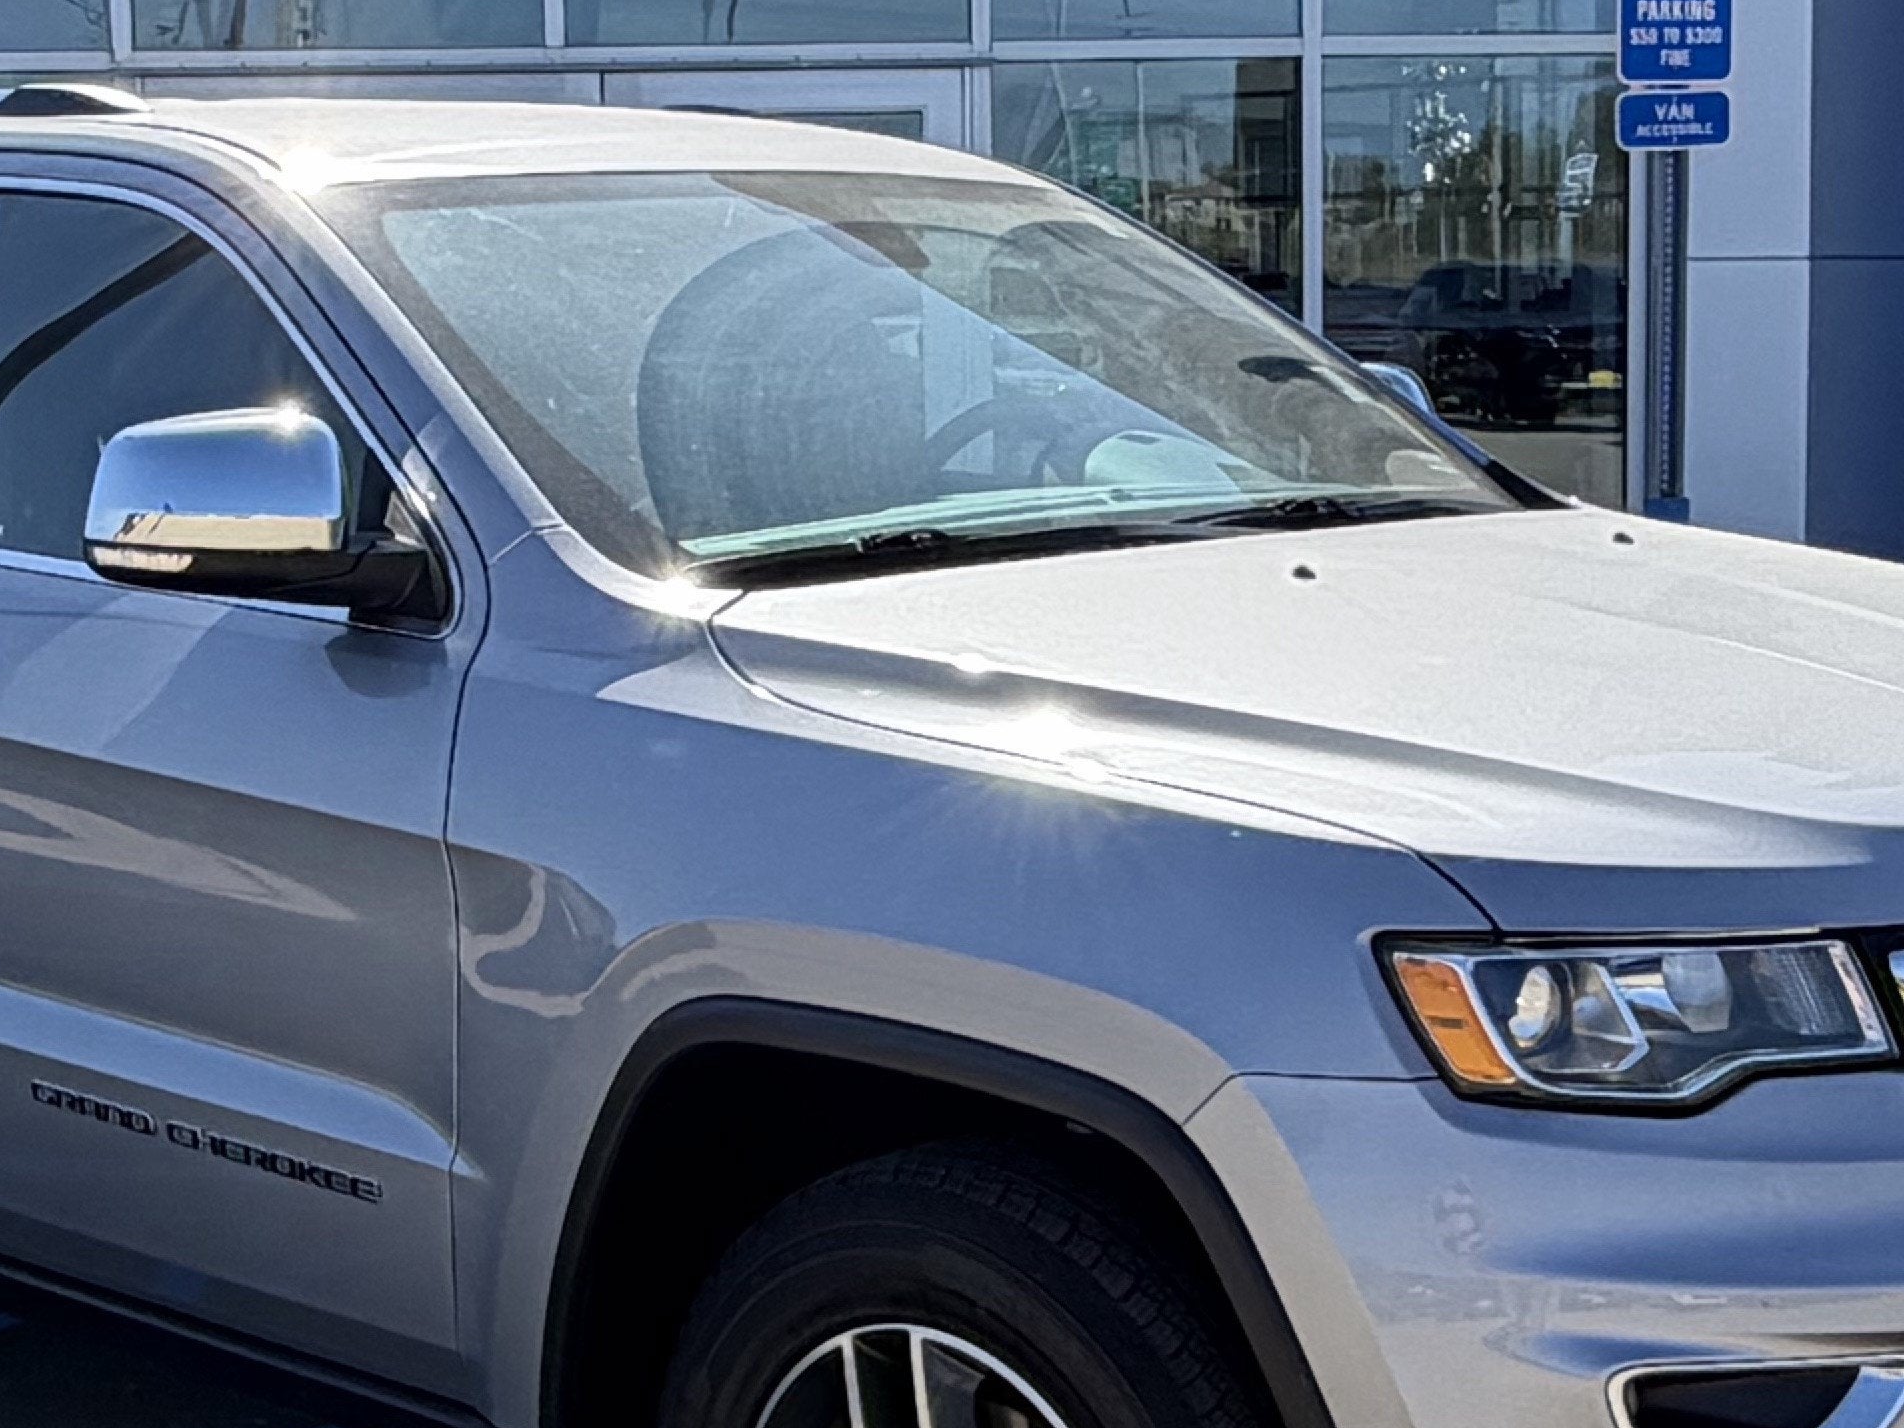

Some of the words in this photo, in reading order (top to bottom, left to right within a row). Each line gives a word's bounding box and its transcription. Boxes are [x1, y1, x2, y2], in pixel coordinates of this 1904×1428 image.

[1637, 0, 1716, 21] PARKING
[1663, 27, 1680, 44] TO
[1660, 49, 1691, 67] FINE
[1654, 103, 1694, 121] VAN
[1635, 122, 1713, 138] ACCESSIBLE
[165, 1119, 383, 1204] CHEROKEE
